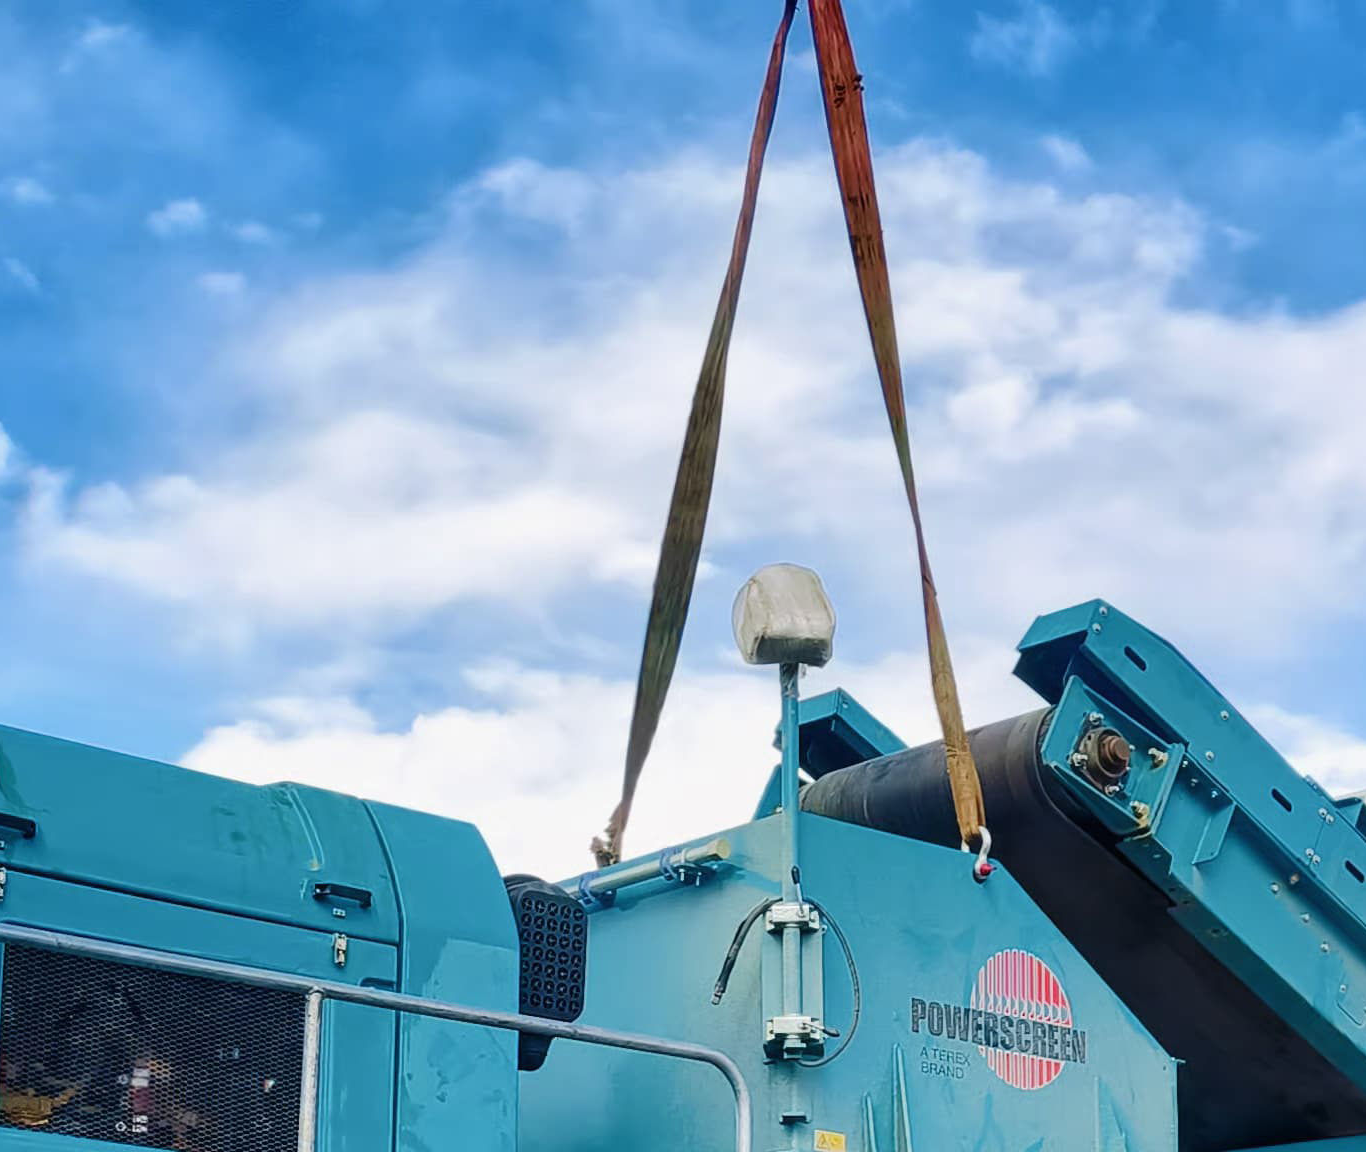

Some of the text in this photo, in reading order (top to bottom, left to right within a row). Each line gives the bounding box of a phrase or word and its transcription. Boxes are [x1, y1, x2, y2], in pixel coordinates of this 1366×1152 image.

[911, 997, 1087, 1065] POWERSCREEN
[919, 1047, 971, 1067] A TEREX
[921, 1062, 965, 1079] BRAND
